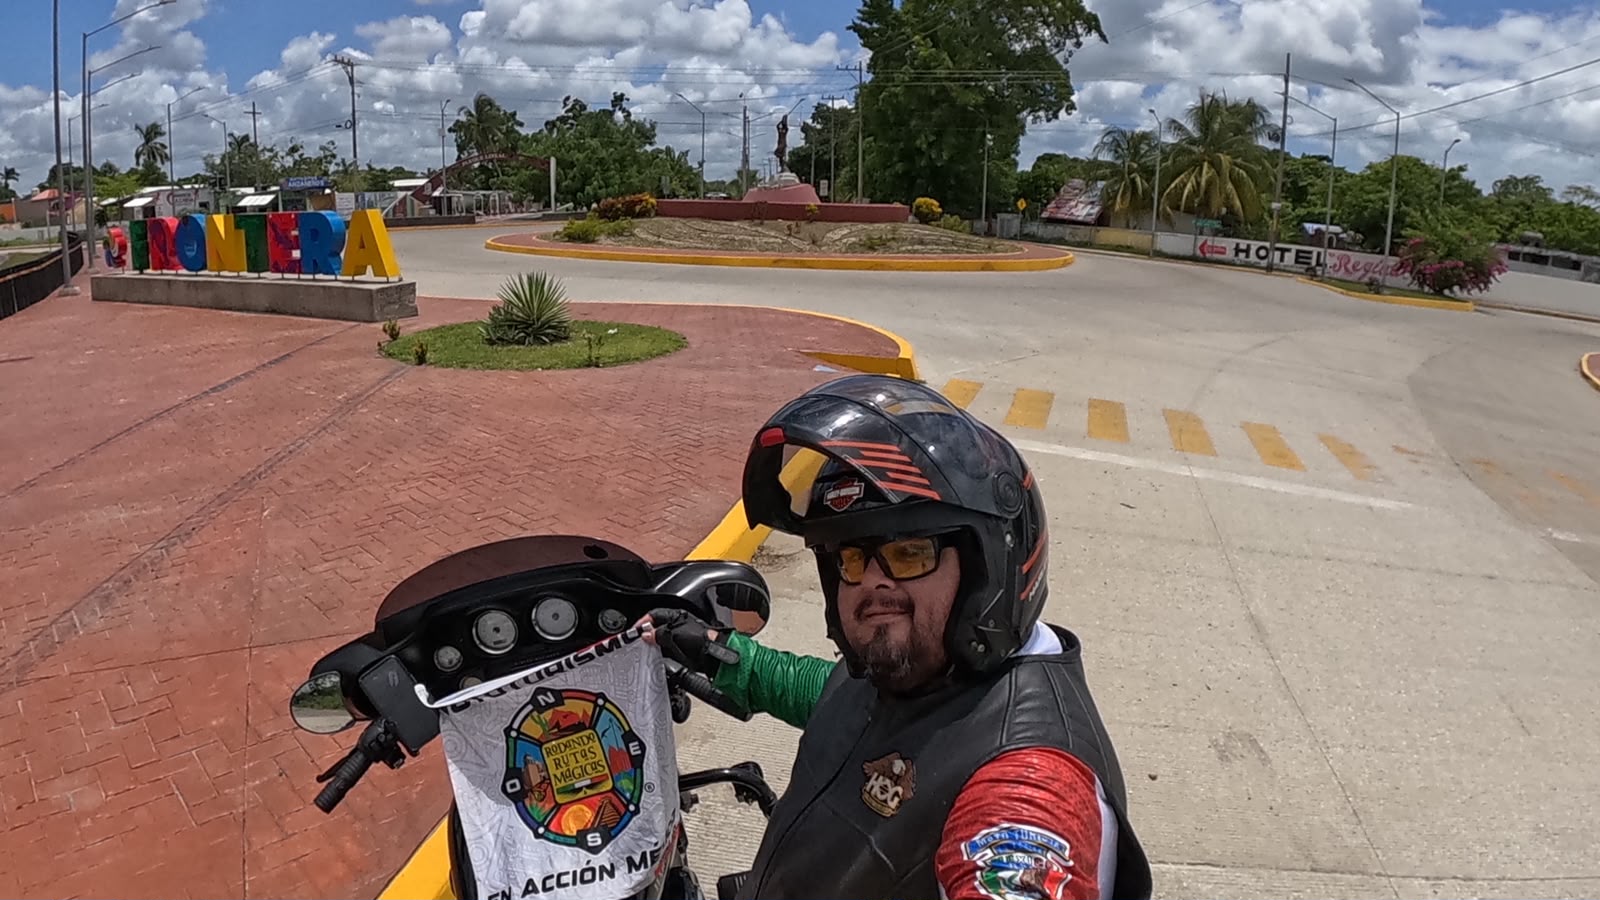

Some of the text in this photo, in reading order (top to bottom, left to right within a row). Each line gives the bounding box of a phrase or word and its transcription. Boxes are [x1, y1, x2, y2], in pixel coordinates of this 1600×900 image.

[1233, 242, 1327, 268] HOTEL
[537, 691, 555, 706] N
[629, 741, 642, 756] E
[505, 778, 521, 793] O
[586, 832, 602, 847] S
[521, 860, 616, 899] ACCIÓN
